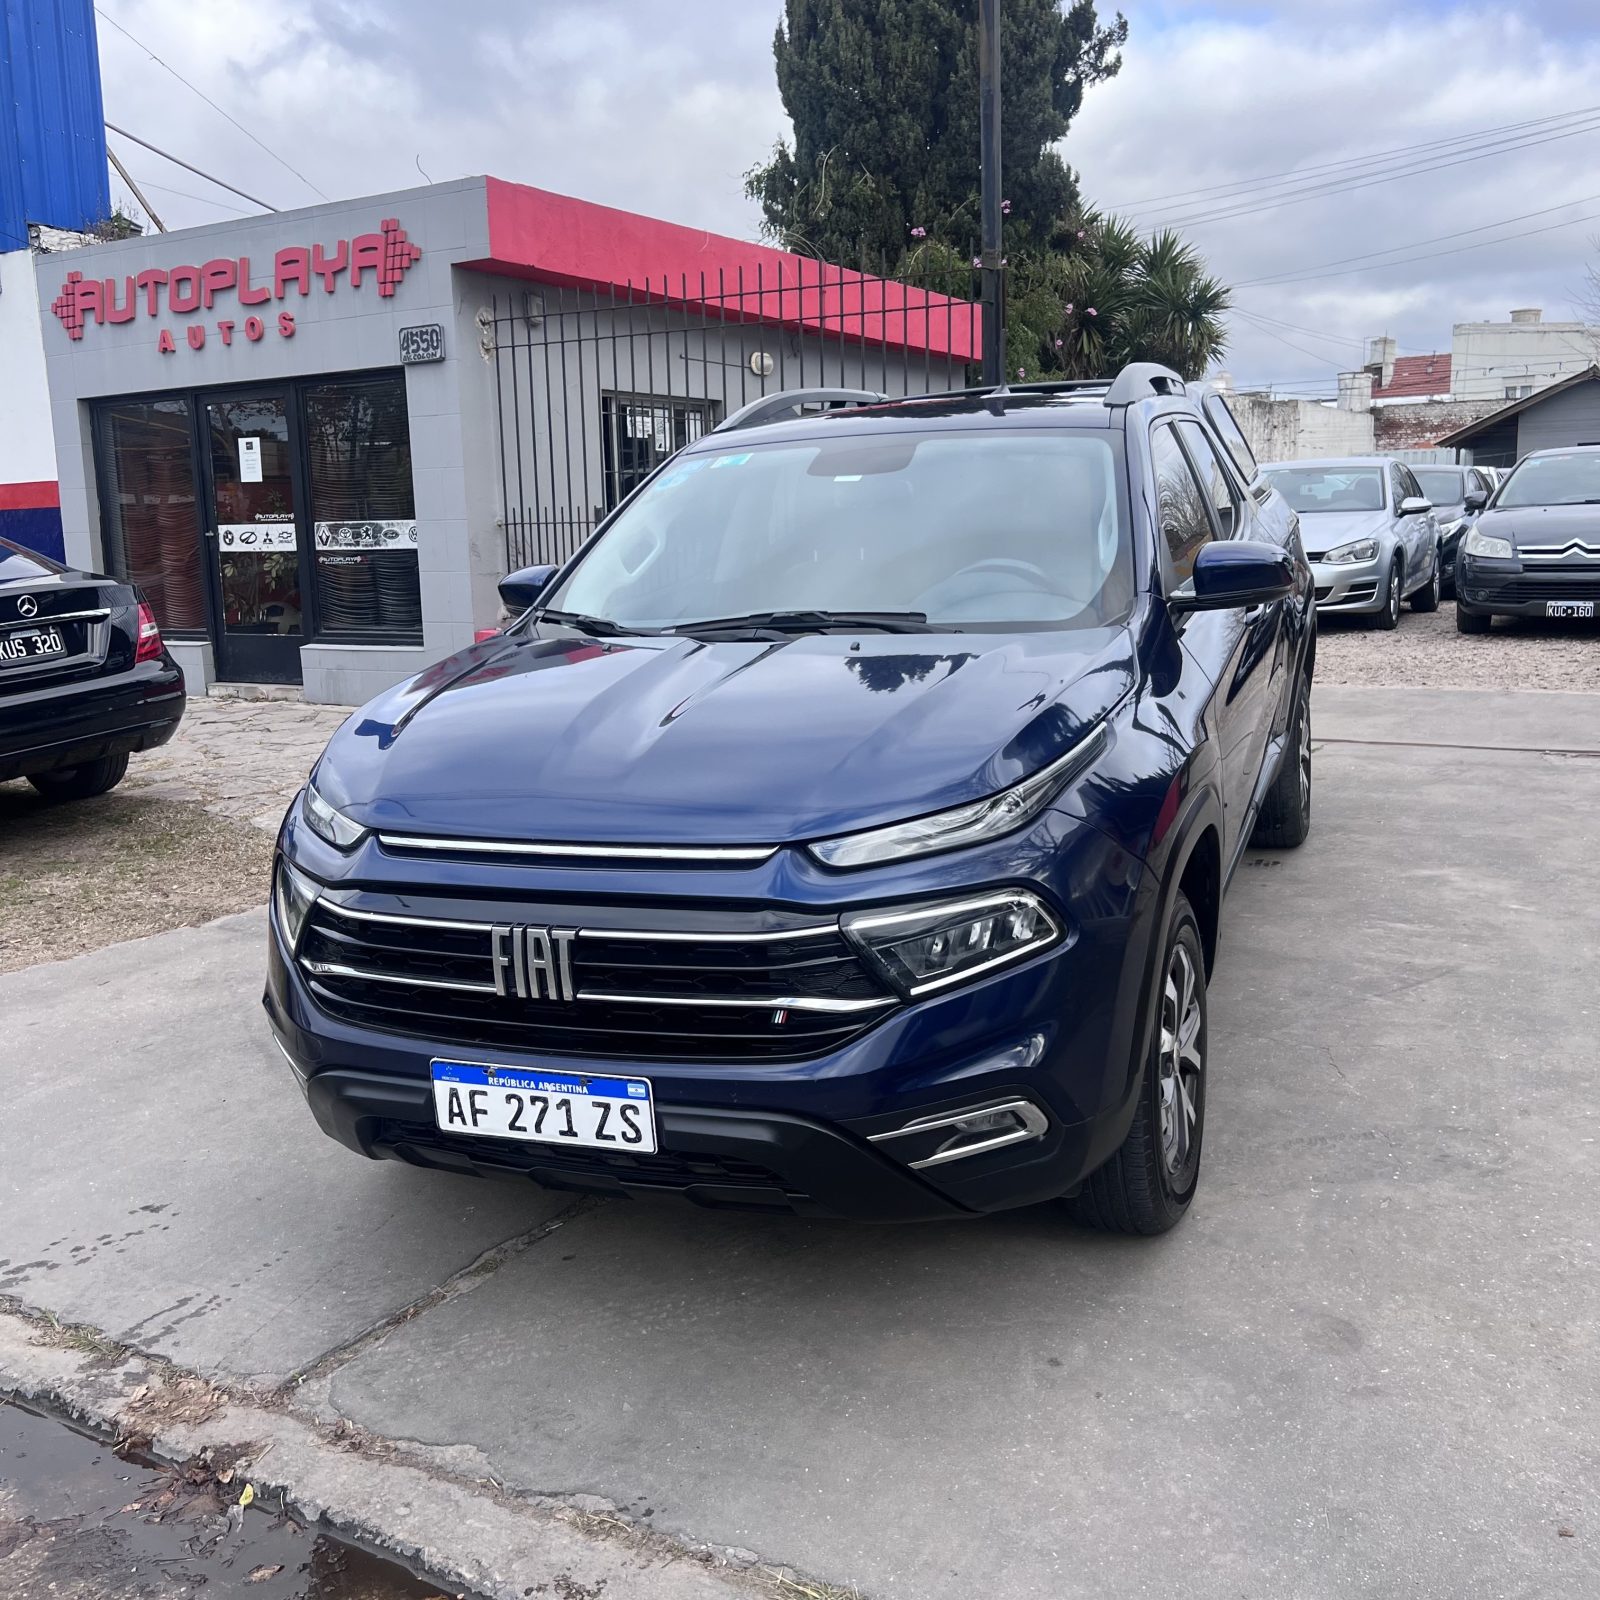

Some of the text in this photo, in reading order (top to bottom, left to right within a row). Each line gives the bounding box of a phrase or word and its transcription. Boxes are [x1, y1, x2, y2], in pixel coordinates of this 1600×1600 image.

[73, 233, 388, 326] AUTOPLAYA
[158, 311, 296, 354] AUTOS
[401, 329, 440, 354] 4550
[256, 512, 293, 520] AUTOPLAYA
[1548, 606, 1592, 617] KUC 160
[31, 633, 62, 654] 320
[491, 926, 577, 1001] FIAT
[487, 1076, 589, 1095] REPÚBLICA ARGENTINA
[448, 1086, 643, 1144] AF 271 ZS
